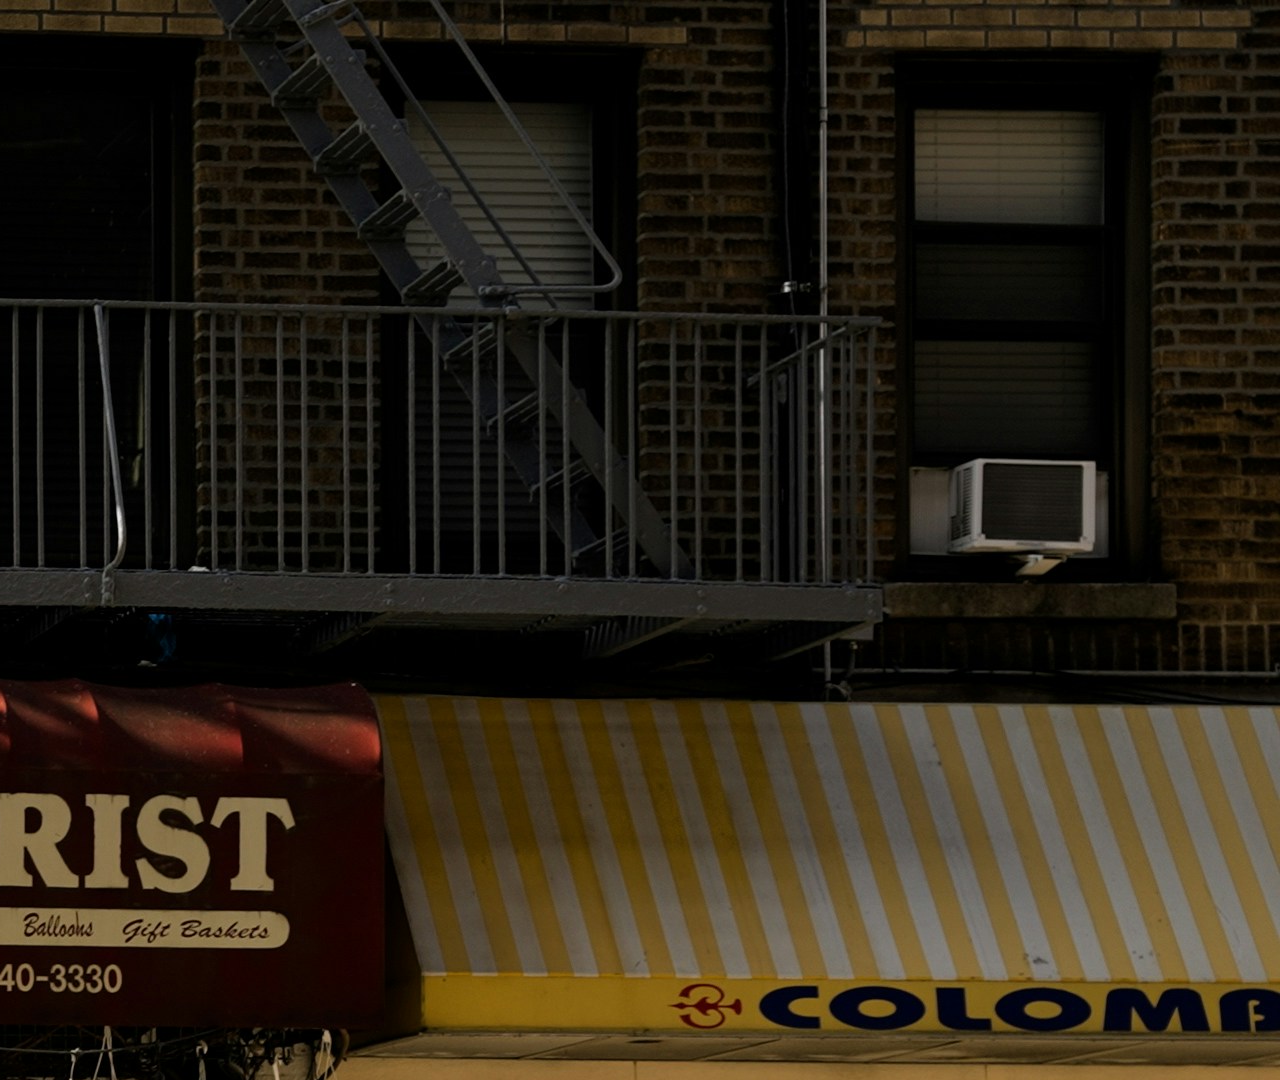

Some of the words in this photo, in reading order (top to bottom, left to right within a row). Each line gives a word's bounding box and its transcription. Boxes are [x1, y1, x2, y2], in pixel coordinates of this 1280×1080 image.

[23, 912, 94, 938] Balloons
[122, 918, 171, 944] Gift
[180, 919, 270, 939] Baskets
